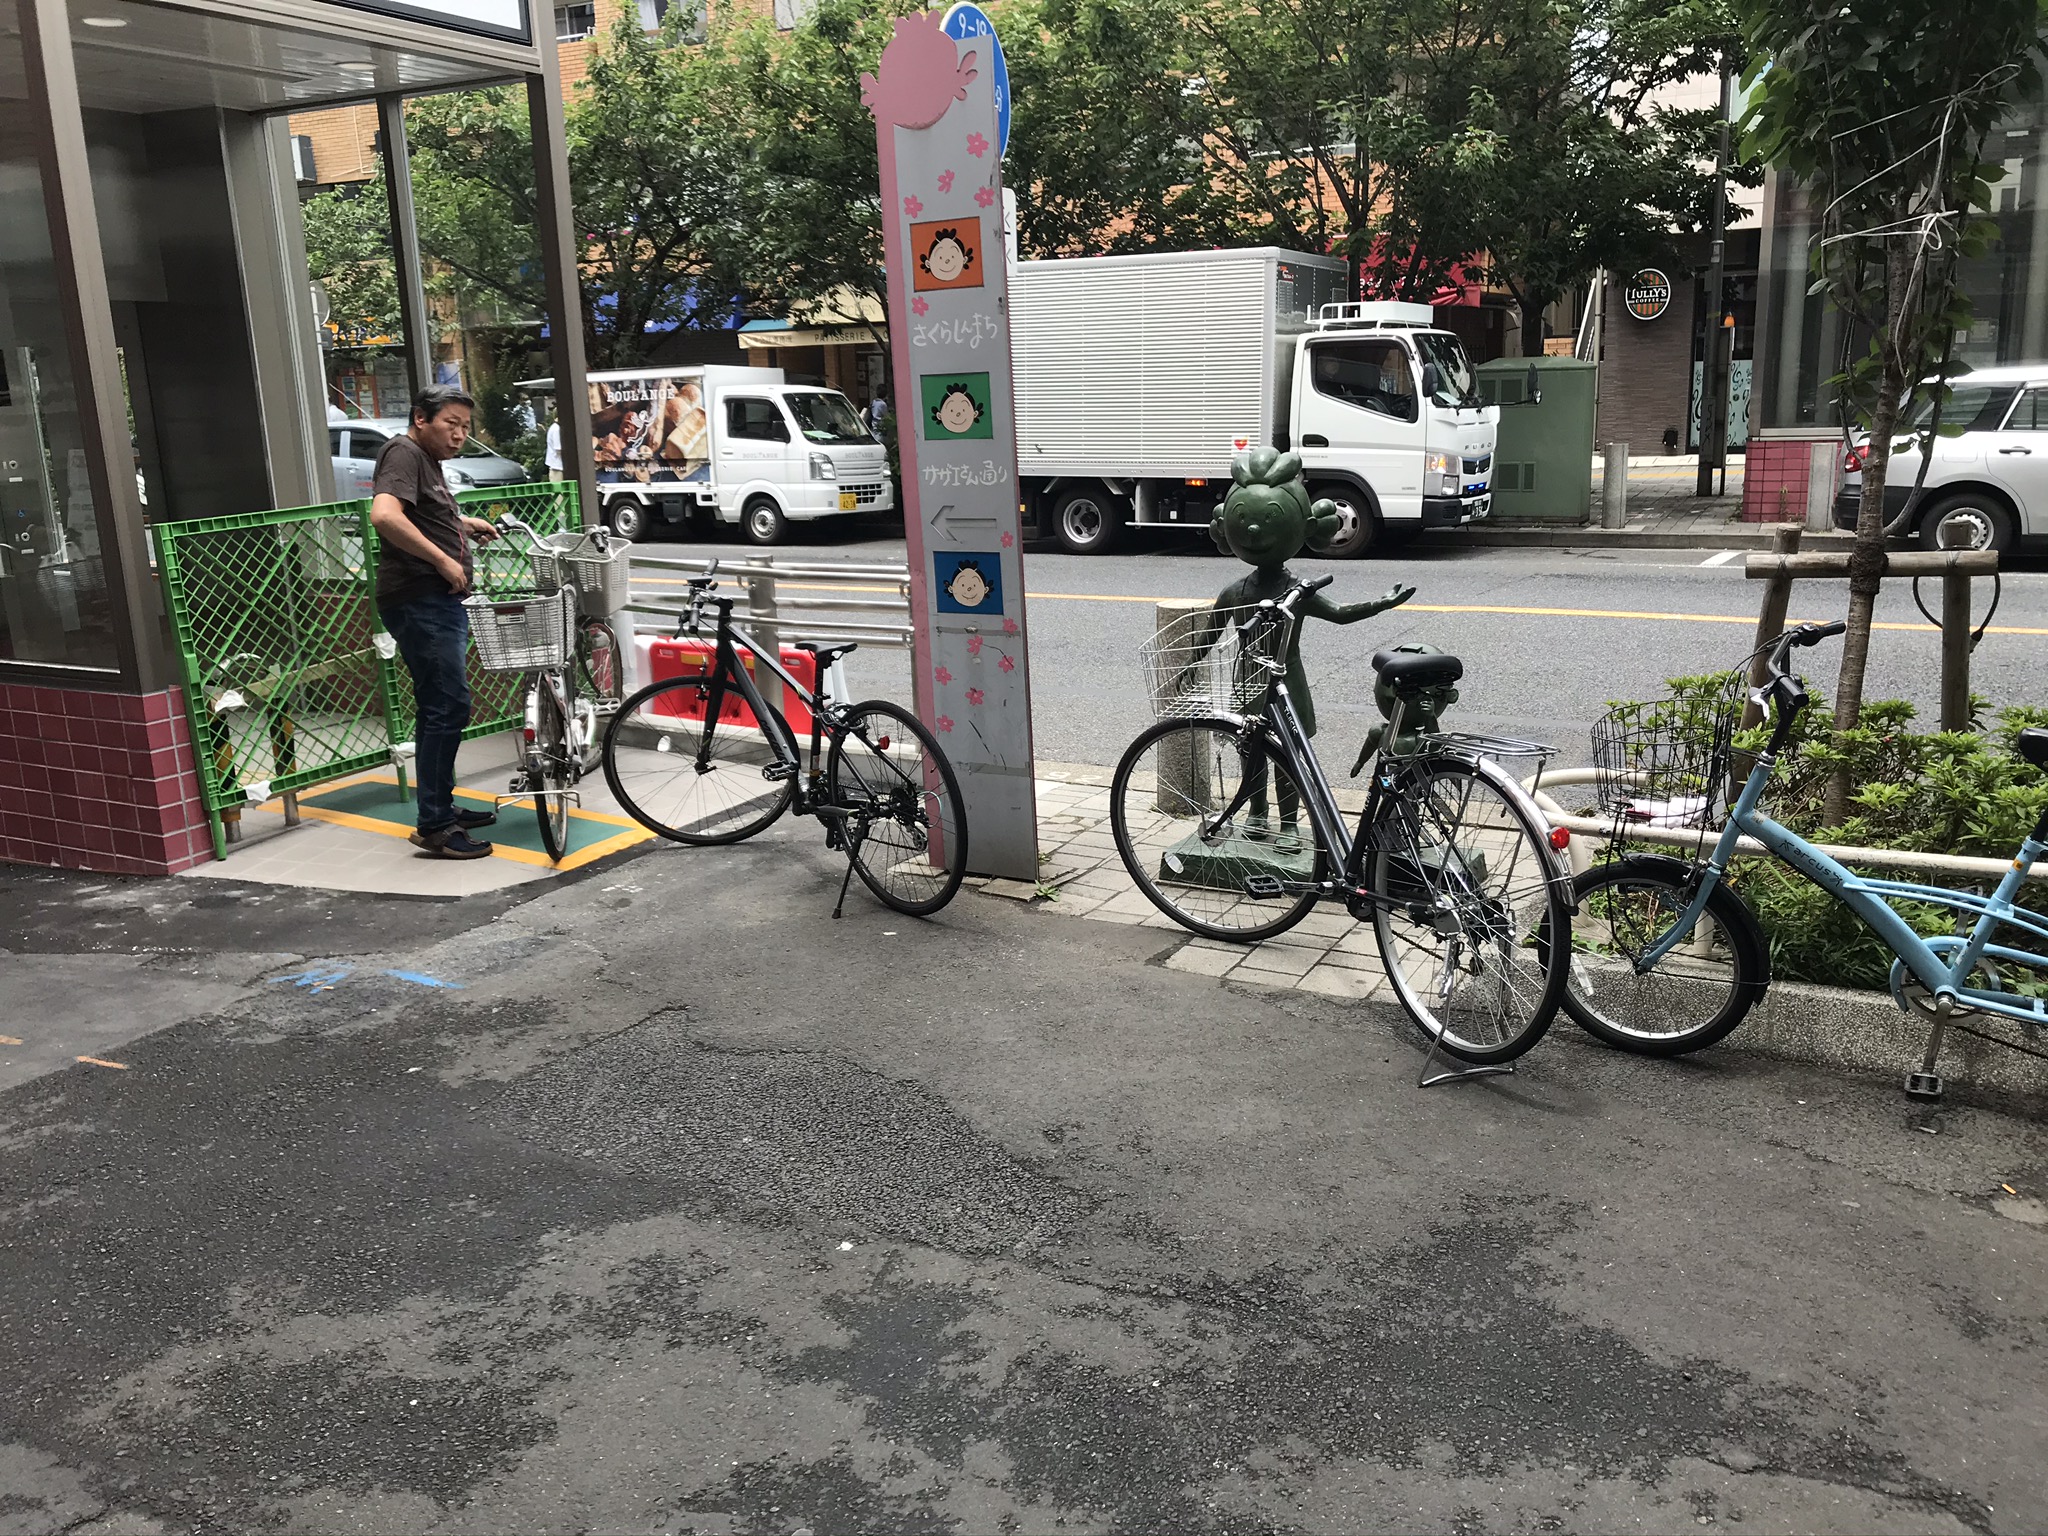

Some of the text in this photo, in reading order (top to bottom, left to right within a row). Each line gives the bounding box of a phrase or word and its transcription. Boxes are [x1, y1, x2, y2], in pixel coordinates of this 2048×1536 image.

[912, 312, 998, 349] さくらしんまち
[922, 460, 1008, 487] サザエさん通り
